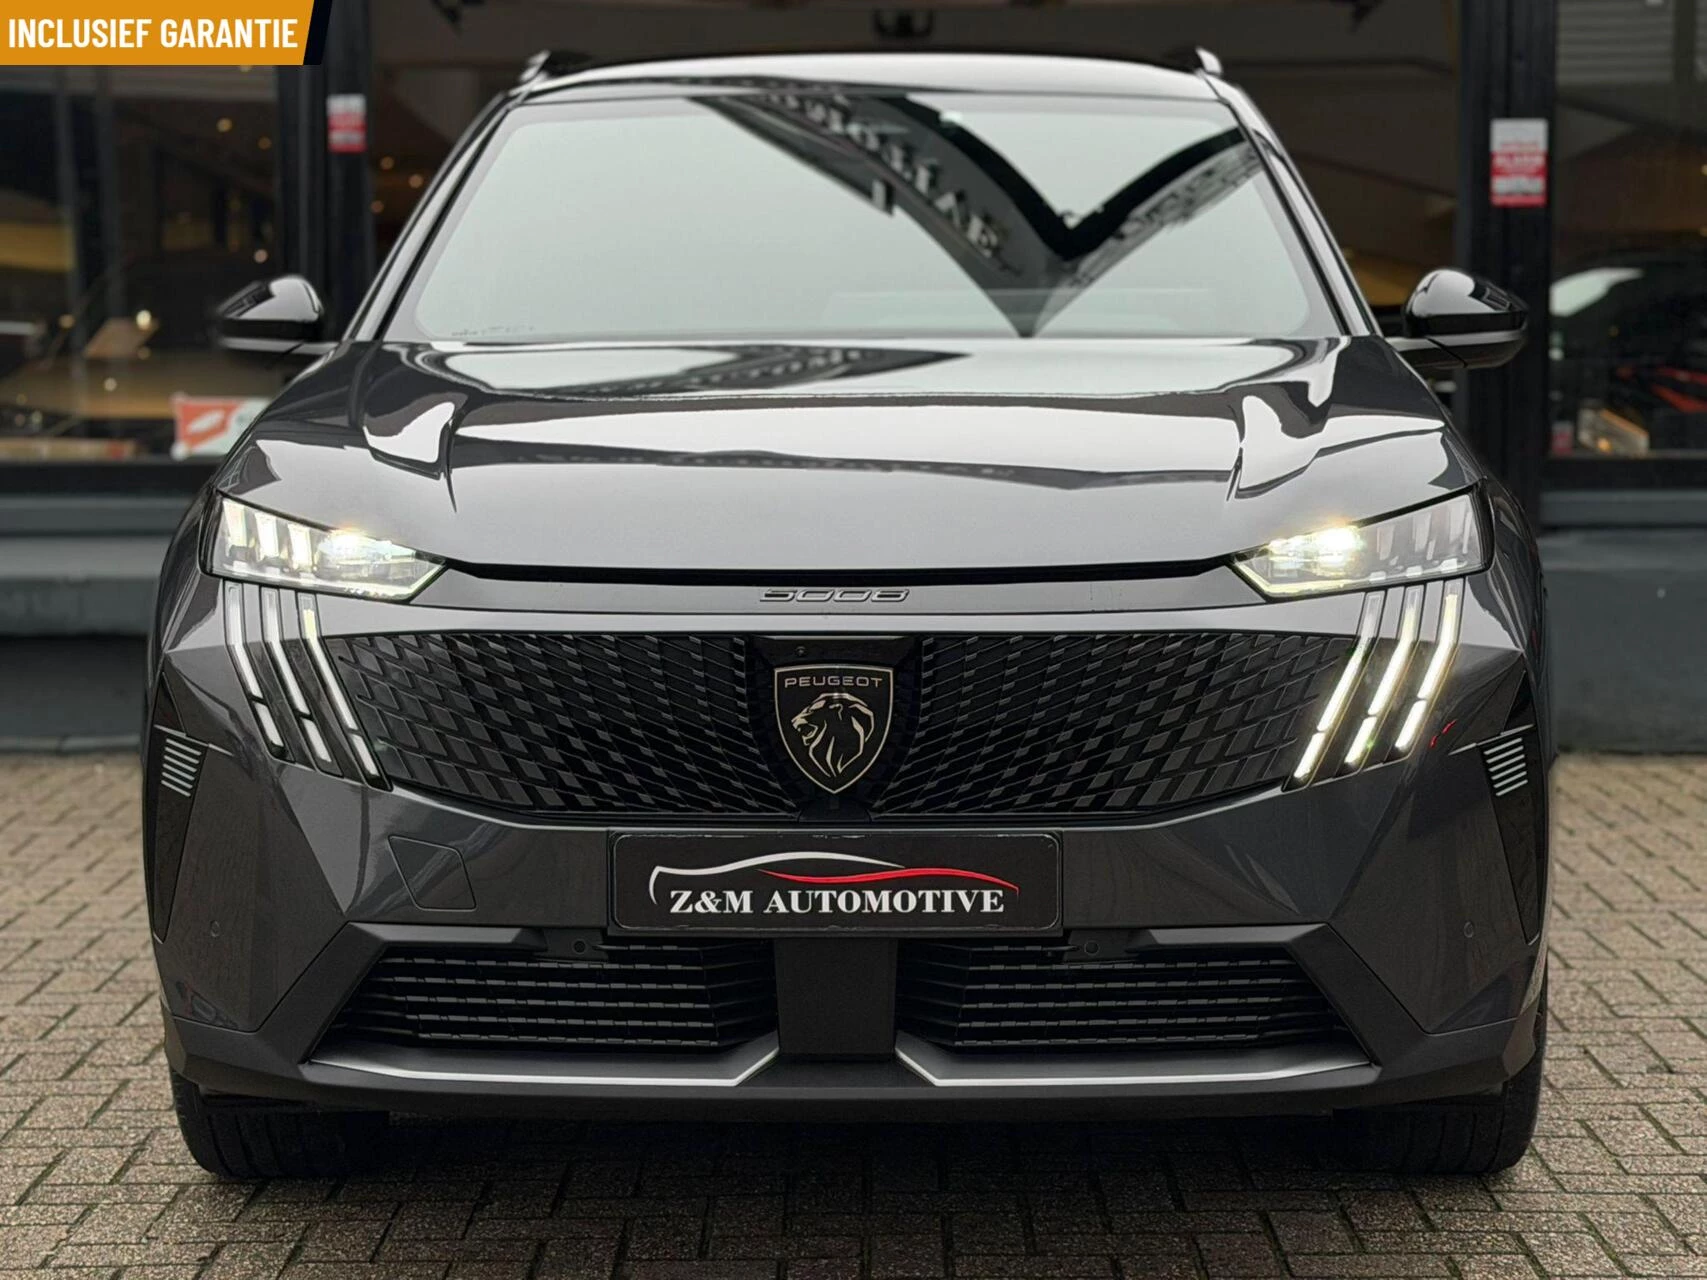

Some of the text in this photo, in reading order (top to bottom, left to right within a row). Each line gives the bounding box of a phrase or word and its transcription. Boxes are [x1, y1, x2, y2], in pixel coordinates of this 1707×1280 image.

[759, 588, 910, 602] 5008
[785, 676, 882, 687] PEUGEOT
[671, 890, 1003, 913] Z&M AUTOMOTIVE
